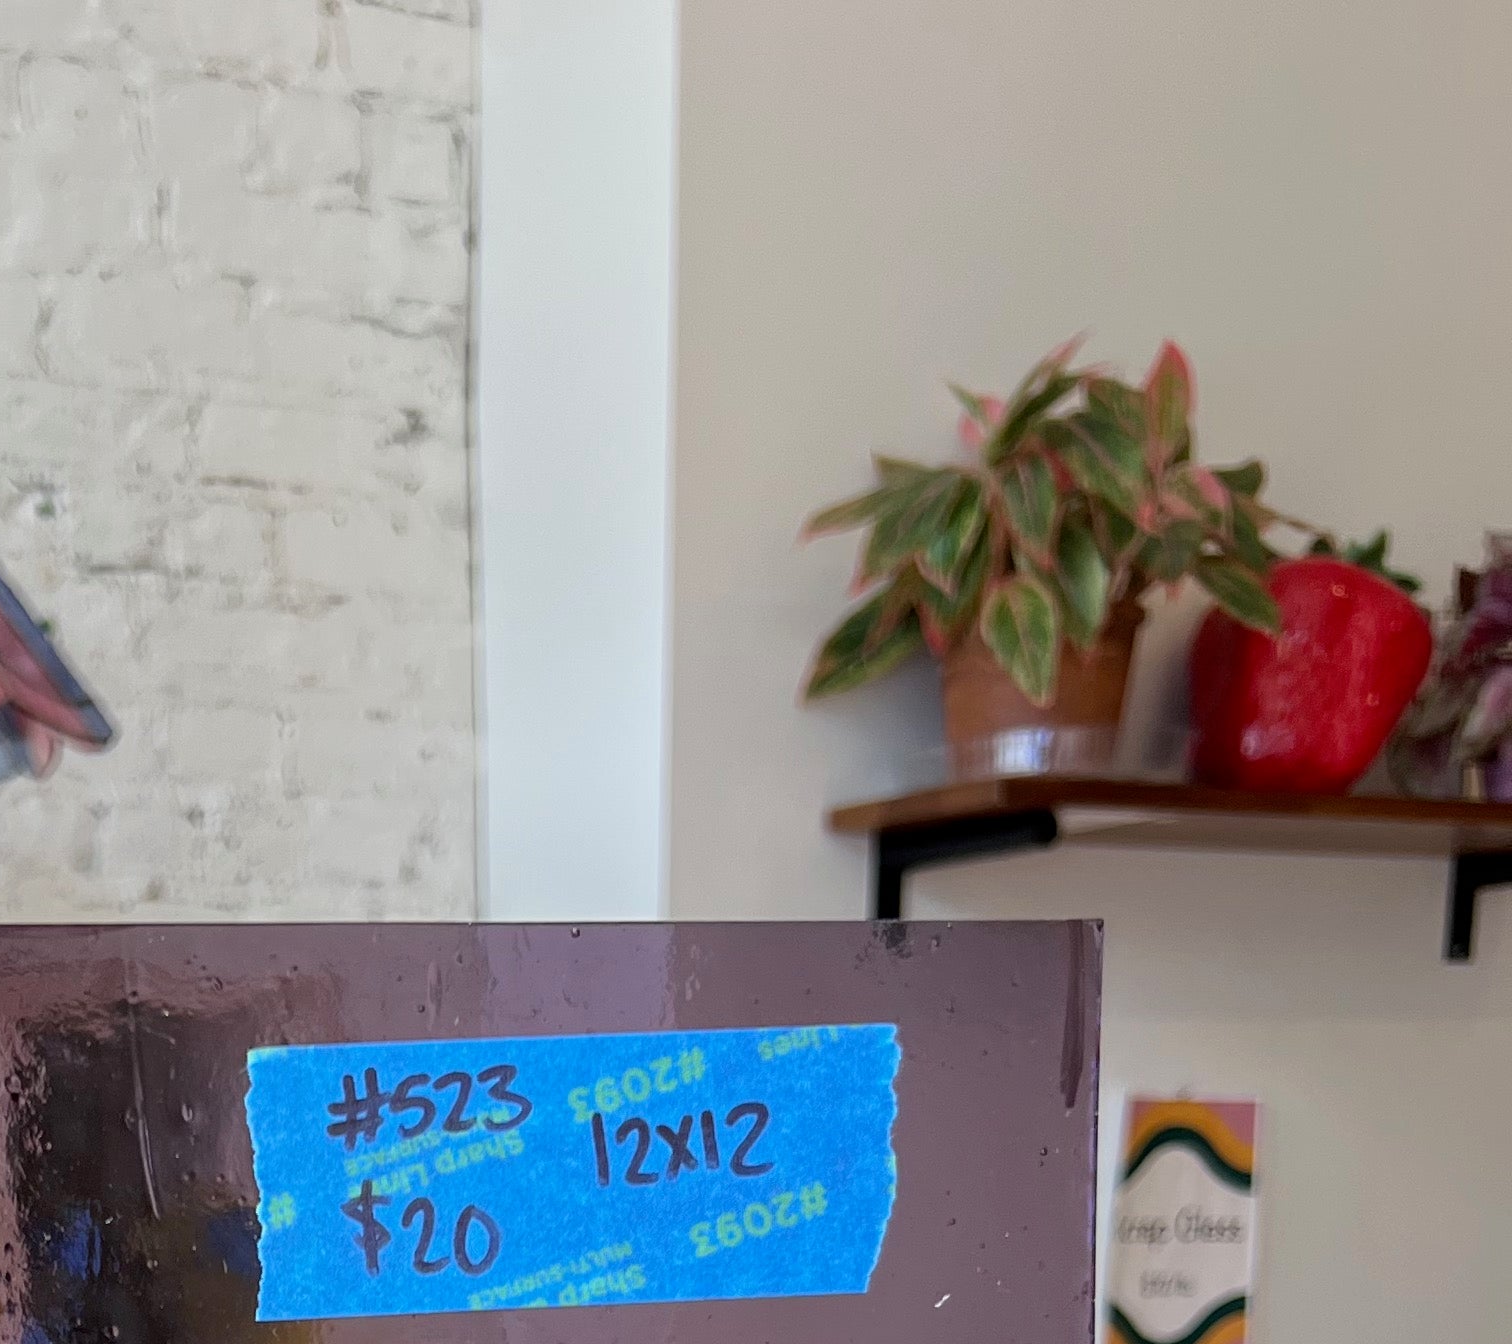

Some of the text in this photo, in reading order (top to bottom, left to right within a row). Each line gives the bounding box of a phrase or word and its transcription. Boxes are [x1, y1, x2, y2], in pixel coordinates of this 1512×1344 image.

[327, 1065, 532, 1151] #523
[568, 1047, 705, 1123] #2093
[592, 1102, 775, 1187] 12x12
[341, 1178, 502, 1277] $20
[690, 1182, 827, 1257] #2093
